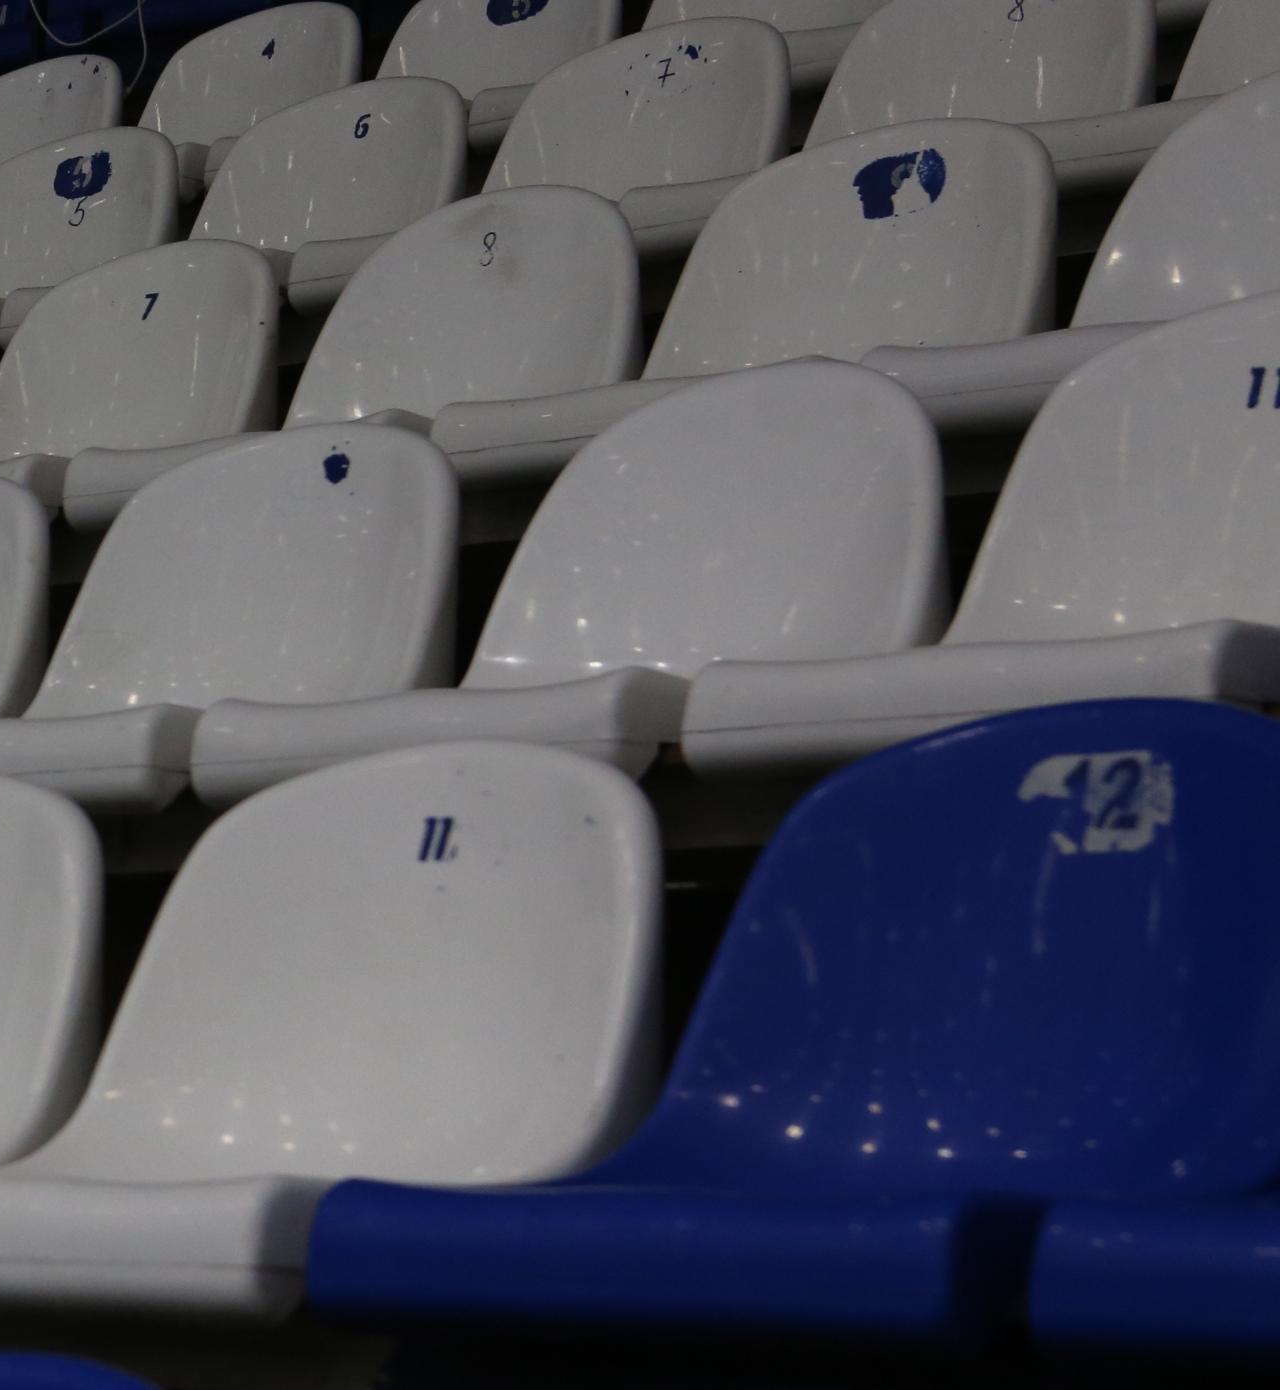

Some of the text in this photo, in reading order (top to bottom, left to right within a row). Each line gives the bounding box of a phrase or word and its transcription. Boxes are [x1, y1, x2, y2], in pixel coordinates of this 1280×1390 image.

[657, 57, 676, 84] 7
[353, 113, 372, 139] 6
[68, 201, 85, 227] 5
[141, 292, 160, 321] 7
